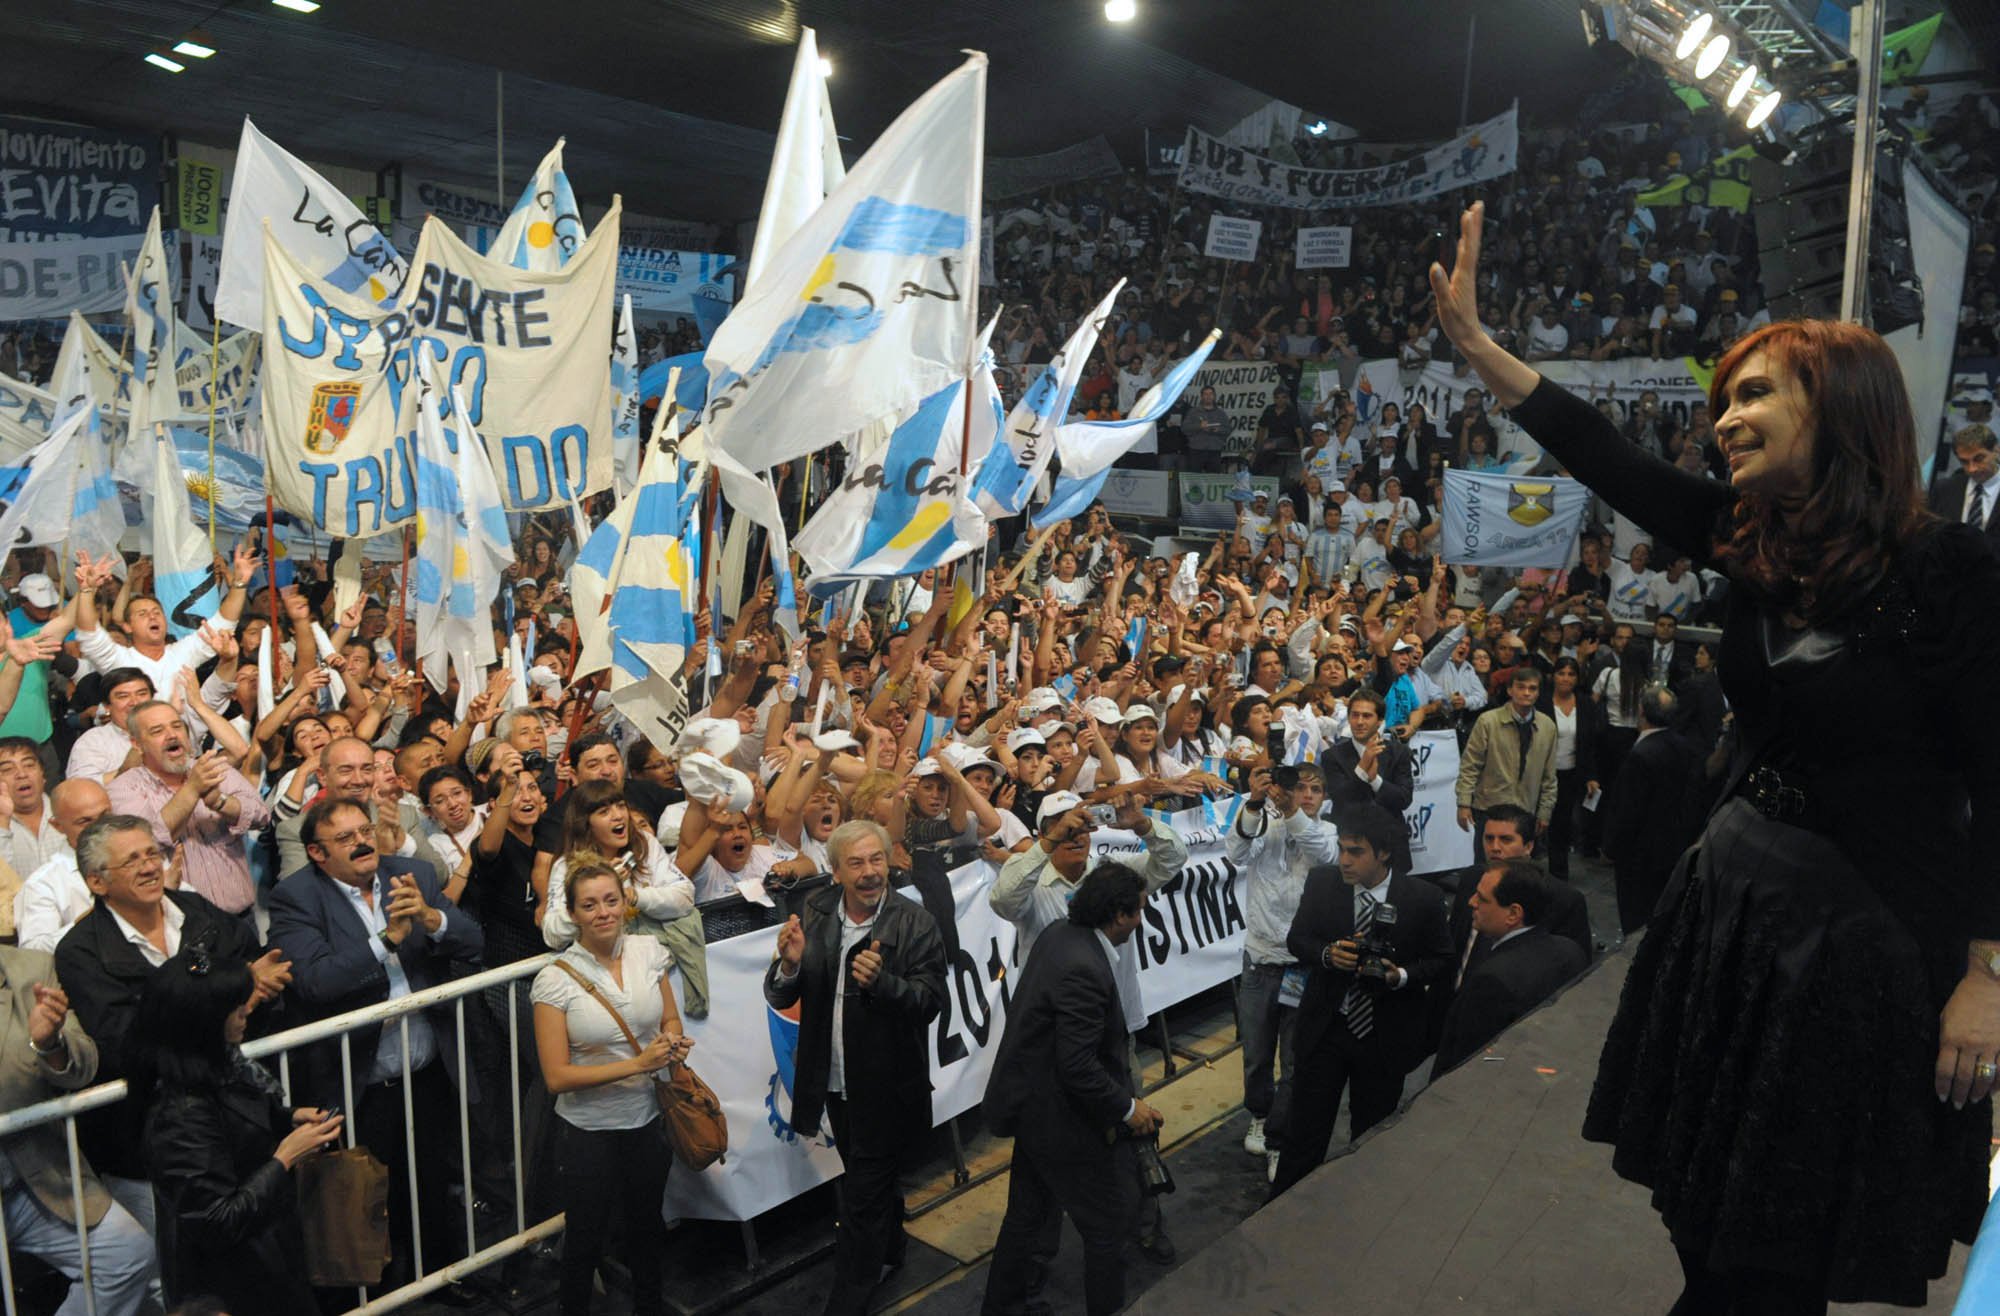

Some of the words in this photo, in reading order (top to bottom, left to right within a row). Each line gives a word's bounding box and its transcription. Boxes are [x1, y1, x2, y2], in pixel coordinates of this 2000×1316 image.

[194, 166, 215, 225] UOCRA
[1287, 156, 1427, 198] FUERZA
[620, 266, 677, 283] tina
[1463, 479, 1481, 559] RAWSON
